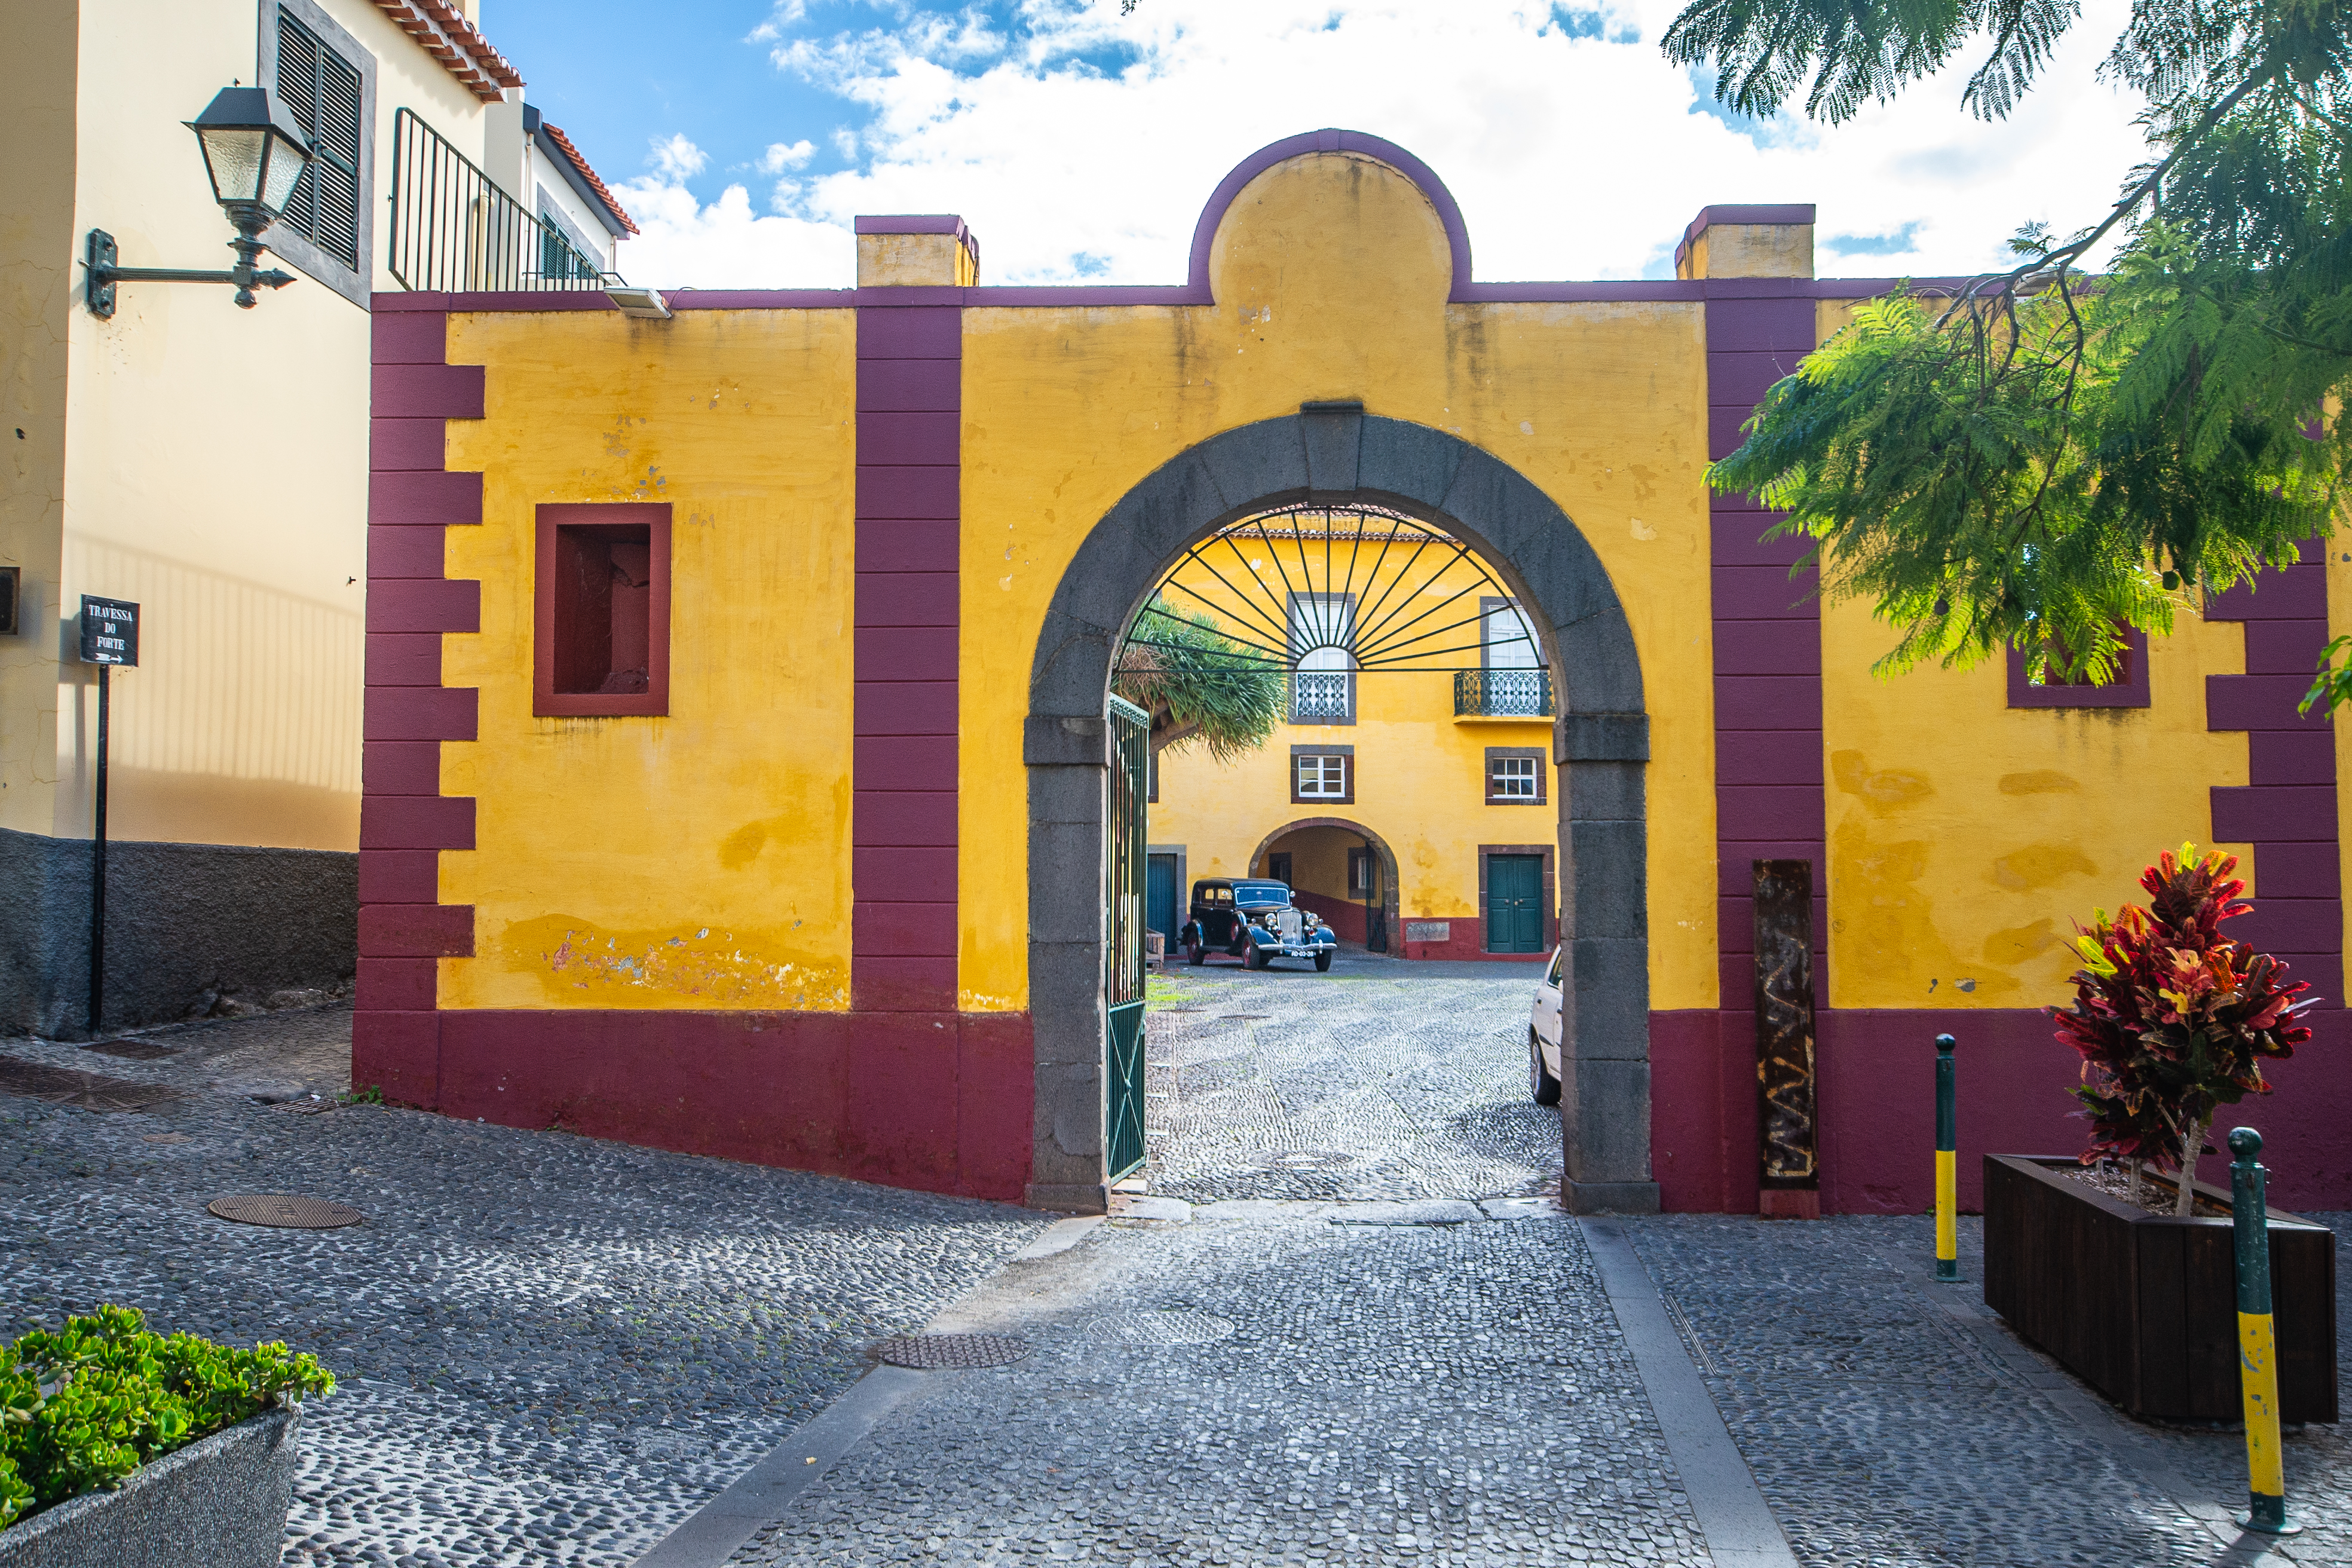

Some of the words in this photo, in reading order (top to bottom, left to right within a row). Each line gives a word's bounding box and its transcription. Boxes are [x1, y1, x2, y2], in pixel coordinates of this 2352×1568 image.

[88, 604, 133, 621] TRAVESSA
[104, 622, 116, 633] DO
[97, 636, 125, 650] FORTE
